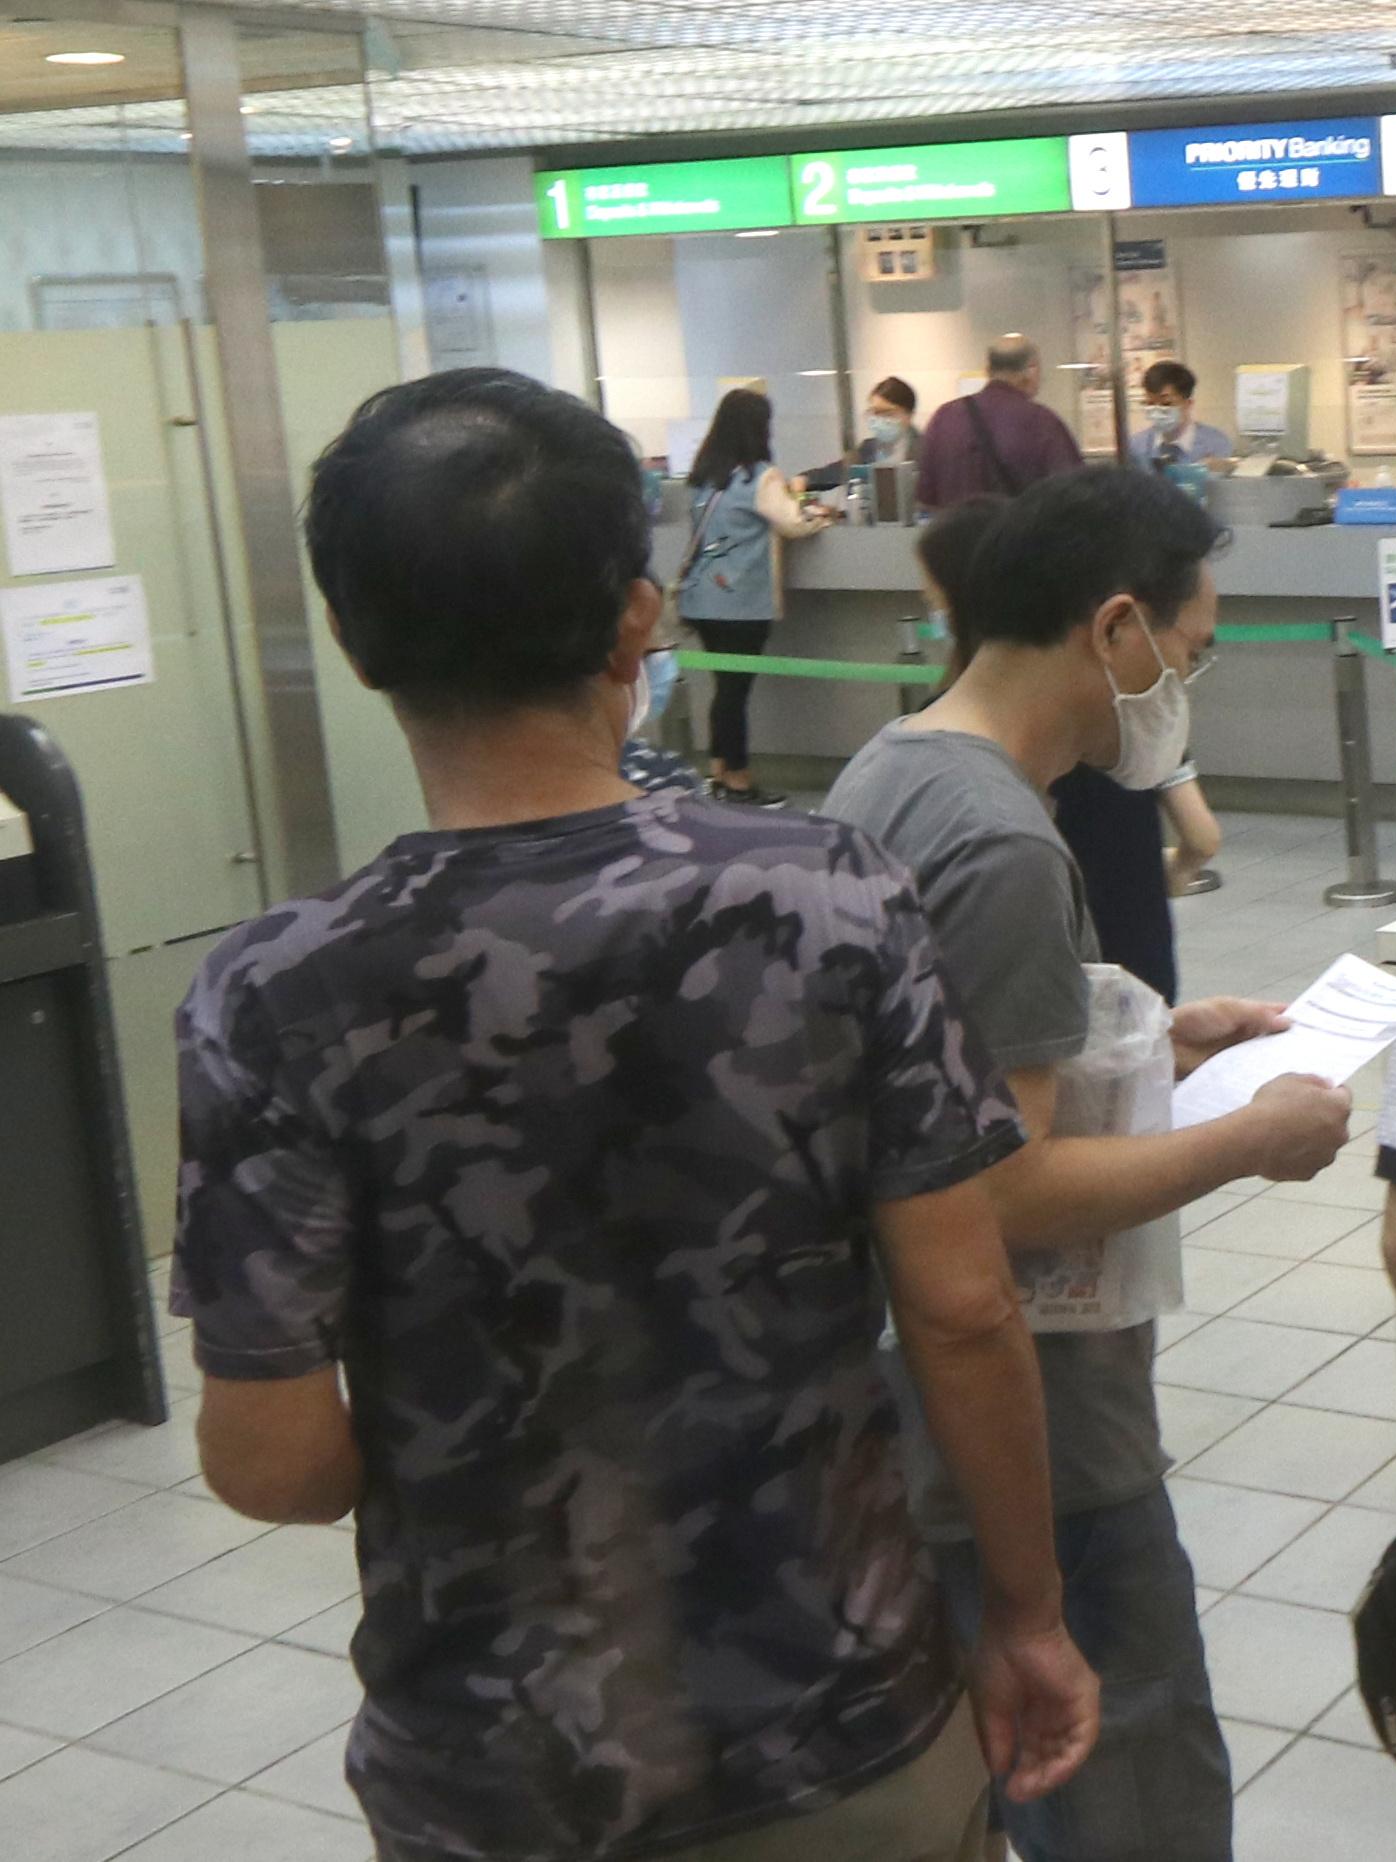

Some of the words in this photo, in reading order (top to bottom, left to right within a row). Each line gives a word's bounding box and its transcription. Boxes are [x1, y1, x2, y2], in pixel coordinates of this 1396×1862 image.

[1185, 137, 1289, 164] PRIORITY
[1287, 135, 1371, 159] Banking
[546, 178, 571, 230] 1
[801, 160, 839, 216] 2
